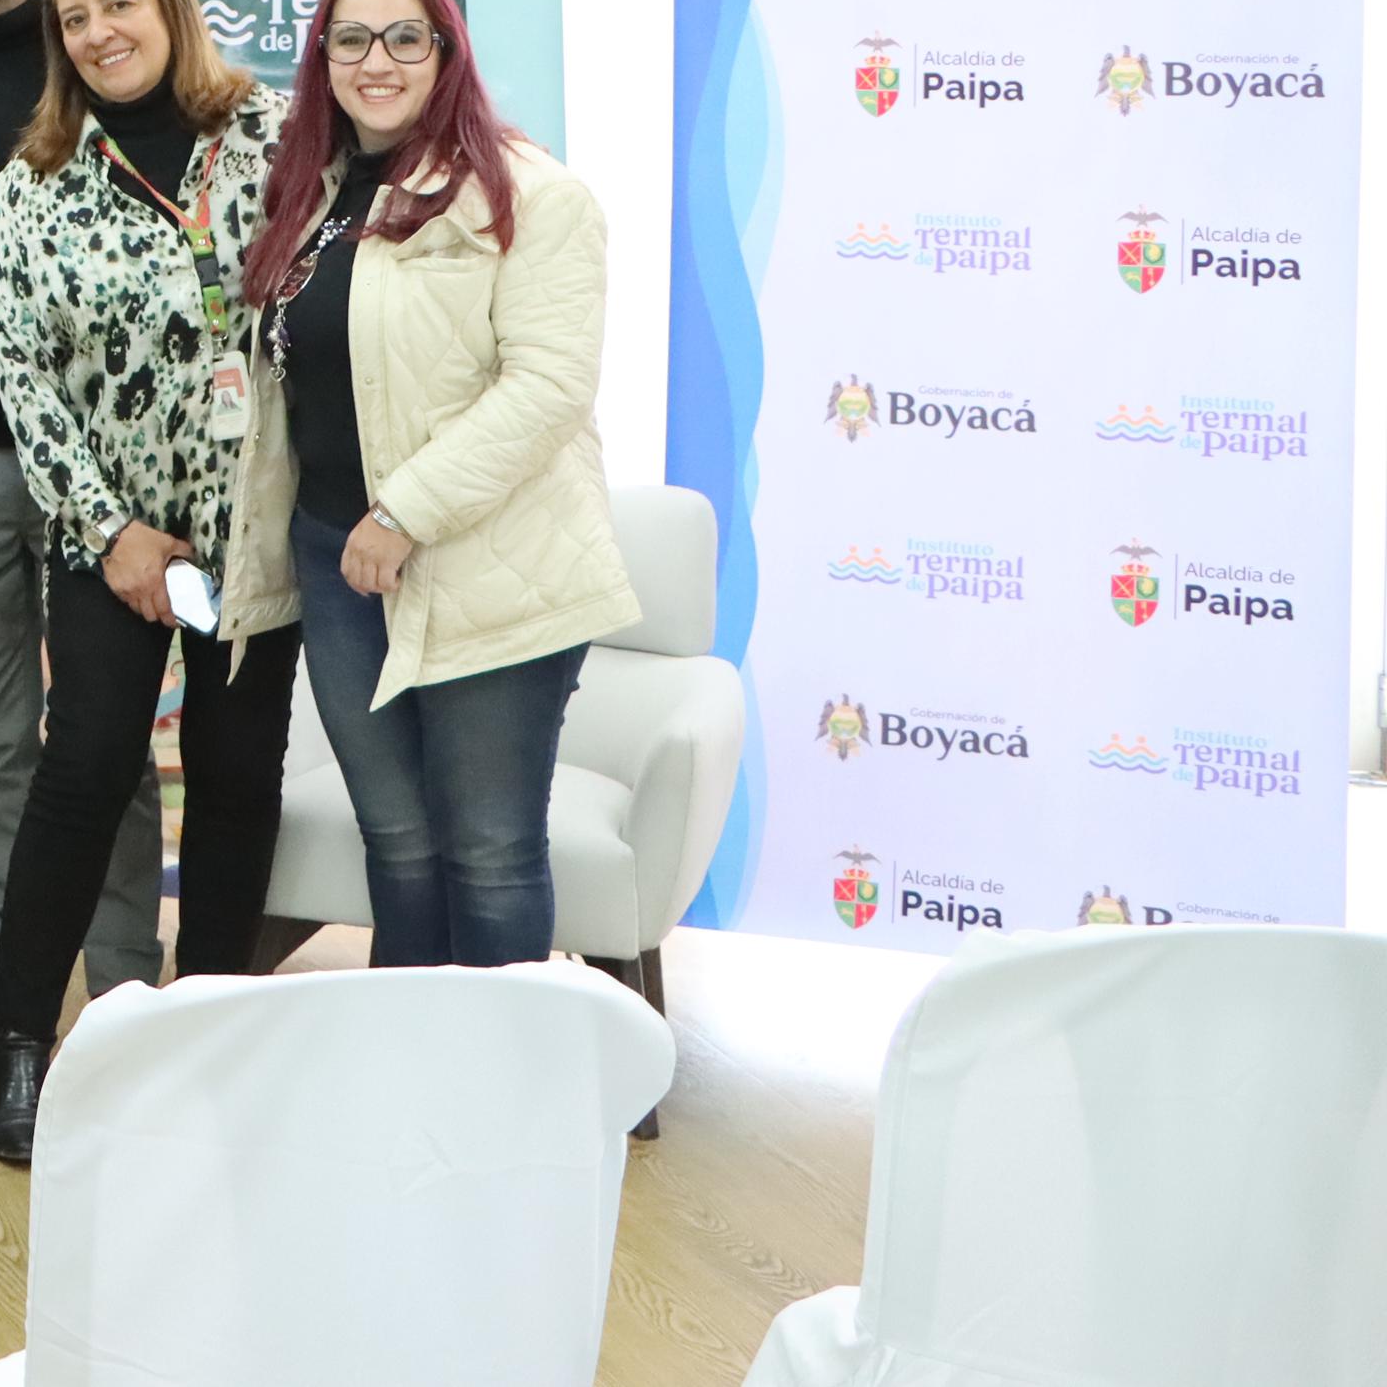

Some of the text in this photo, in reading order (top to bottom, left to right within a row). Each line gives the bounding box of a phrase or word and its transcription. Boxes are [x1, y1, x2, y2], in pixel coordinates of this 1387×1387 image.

[260, 27, 292, 52] de
[1000, 51, 1026, 67] de
[1282, 54, 1300, 65] de
[923, 72, 1024, 109] Paipa
[1162, 61, 1326, 109] Boyacá
[914, 226, 1032, 250] Termal
[1275, 229, 1302, 244] de
[1191, 248, 1302, 287] Paipa
[996, 388, 1014, 399] de
[887, 391, 1037, 439] Boyacá
[1180, 410, 1308, 435] Termal
[906, 553, 1025, 579] Termal
[1269, 569, 1296, 585] de
[1184, 584, 1295, 626] Paipa
[990, 714, 1007, 725] de
[878, 712, 1030, 761] Boyacá
[1173, 743, 1301, 773] Termal
[980, 878, 1005, 895] de
[901, 889, 1003, 932] Paipa
[1263, 912, 1280, 924] de
